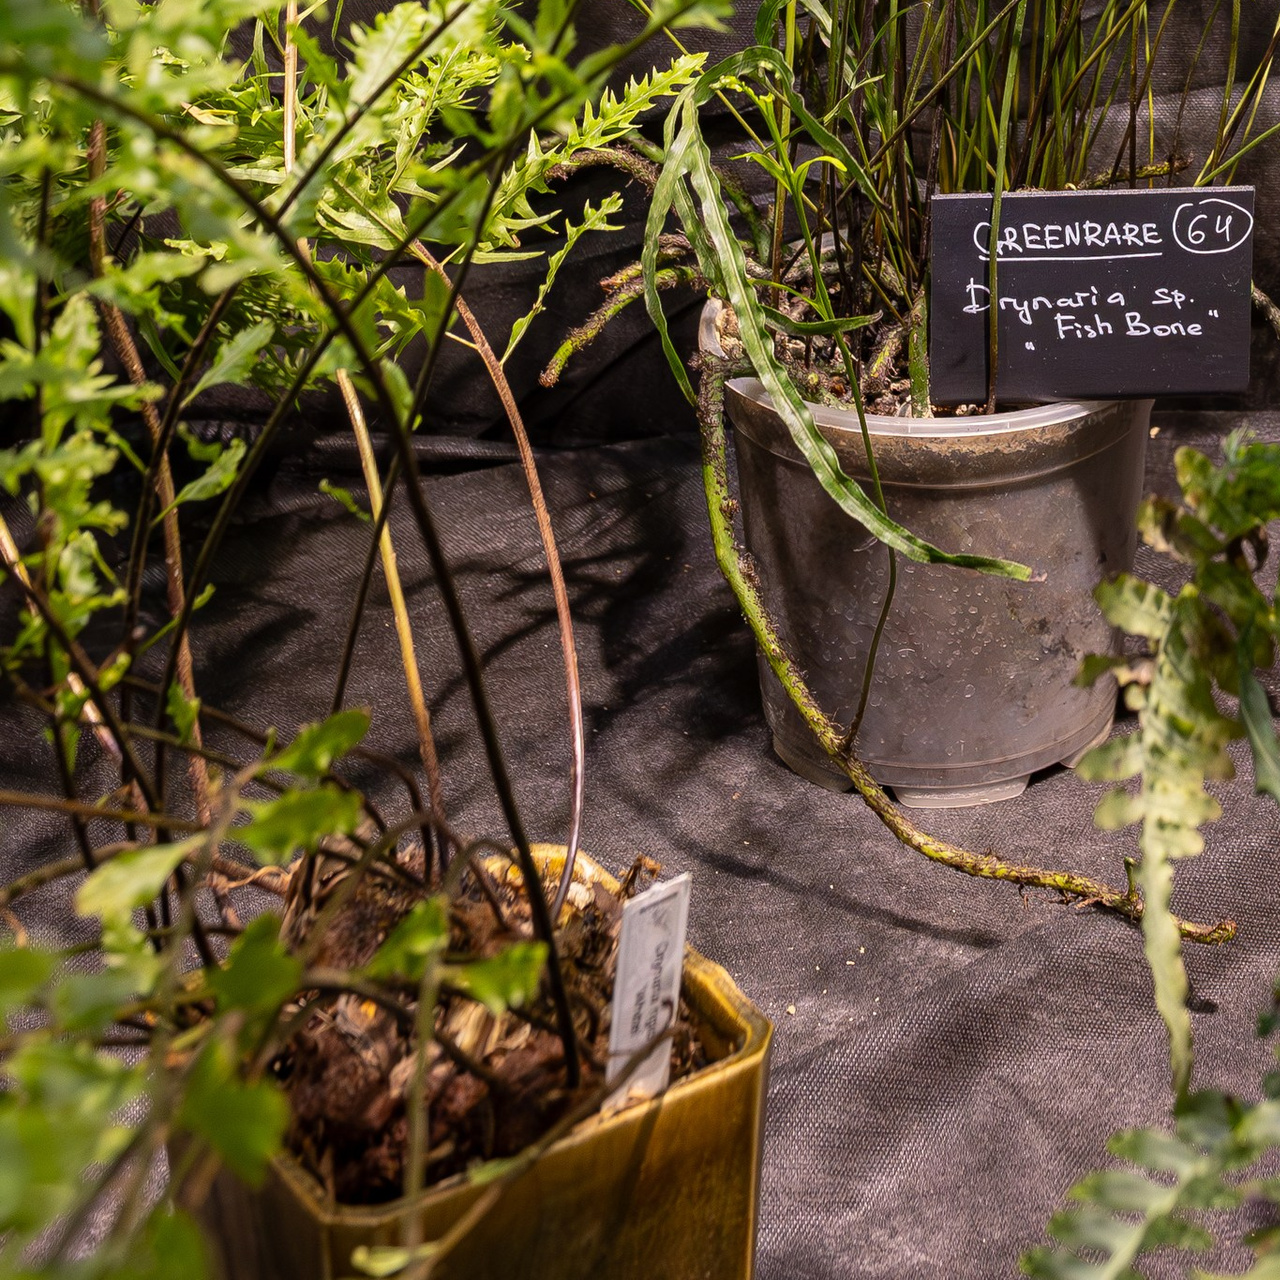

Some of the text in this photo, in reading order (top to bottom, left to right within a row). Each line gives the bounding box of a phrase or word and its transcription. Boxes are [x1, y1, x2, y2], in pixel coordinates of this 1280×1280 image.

[973, 219, 1163, 255] GREENRARE
[1187, 214, 1233, 245] 64
[962, 277, 1125, 325] Drynaria
